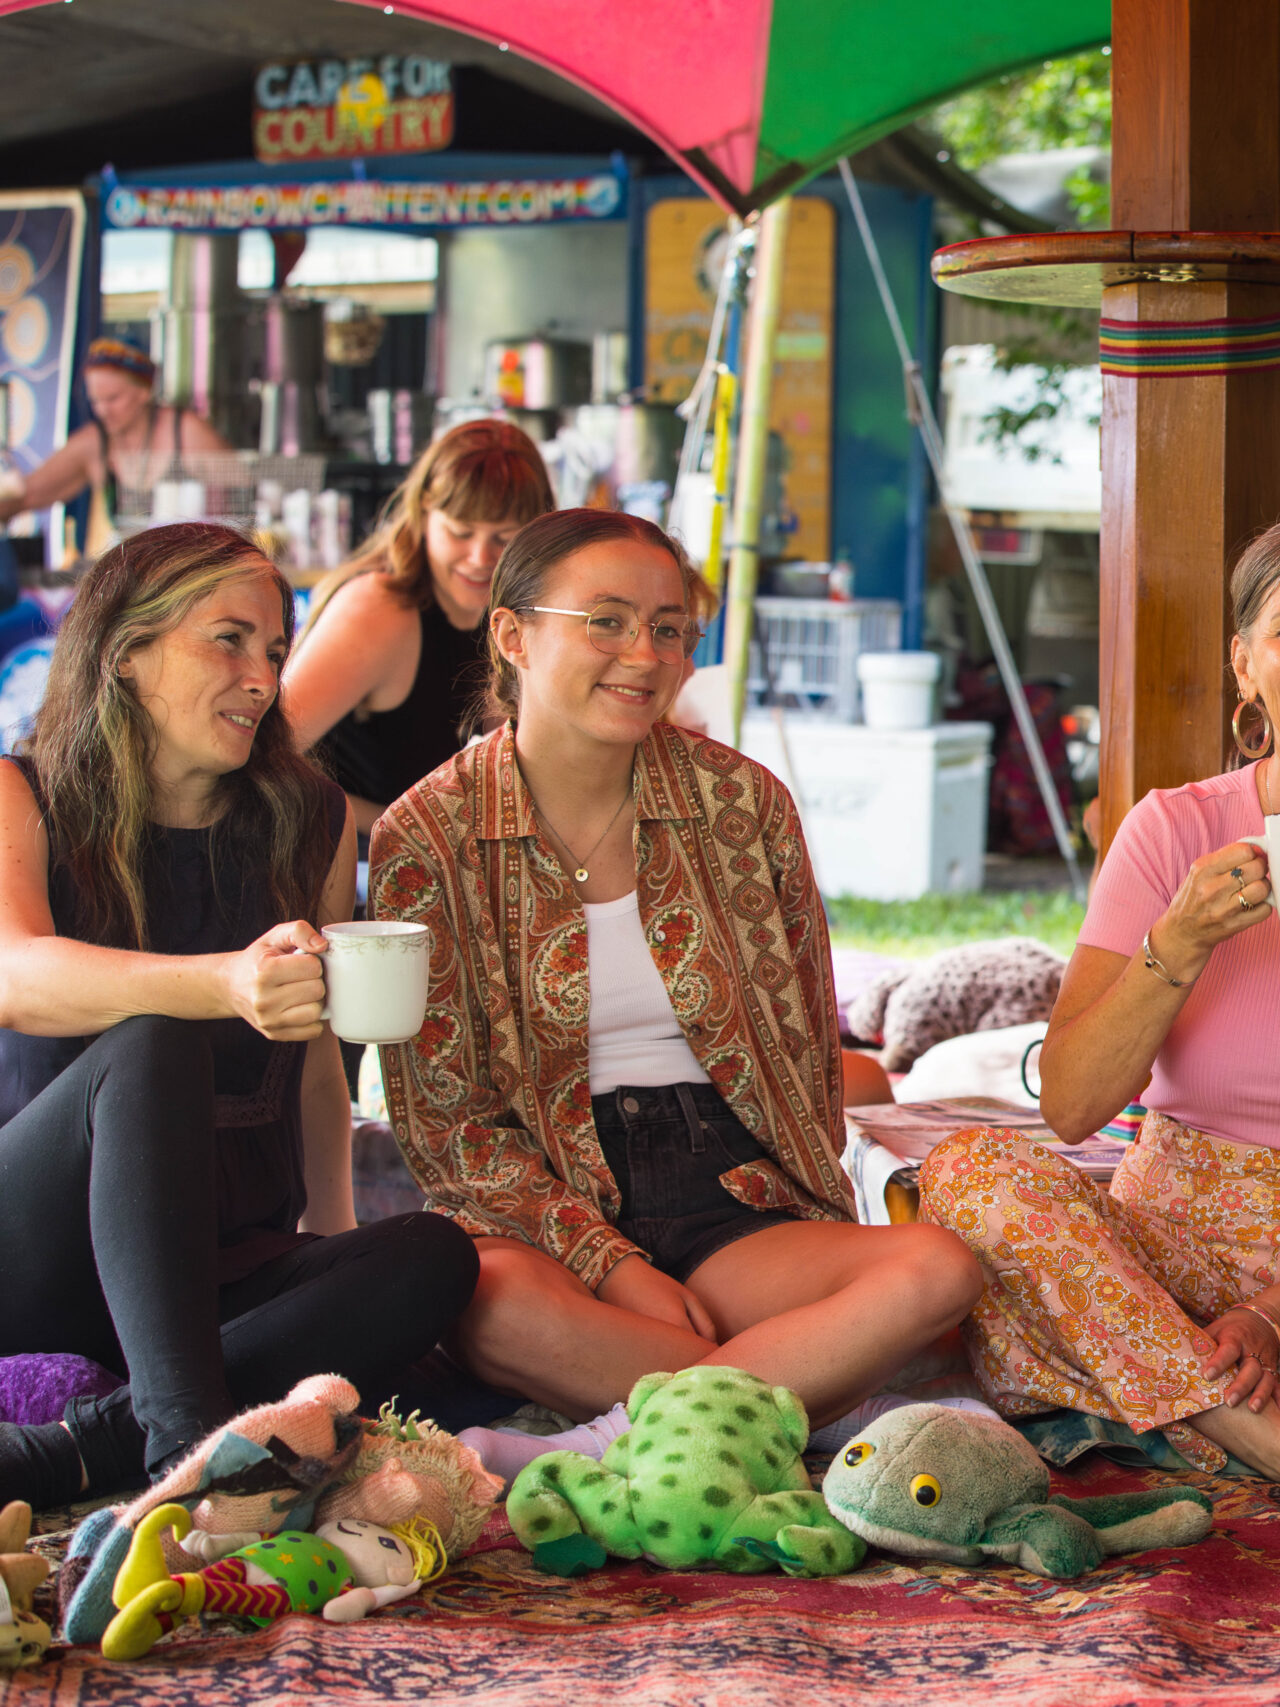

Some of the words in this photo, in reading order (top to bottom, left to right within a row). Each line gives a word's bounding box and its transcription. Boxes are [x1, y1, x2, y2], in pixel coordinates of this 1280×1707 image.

[255, 61, 375, 110] CARE
[380, 54, 451, 98] FOR
[255, 101, 450, 155] COUNTRY
